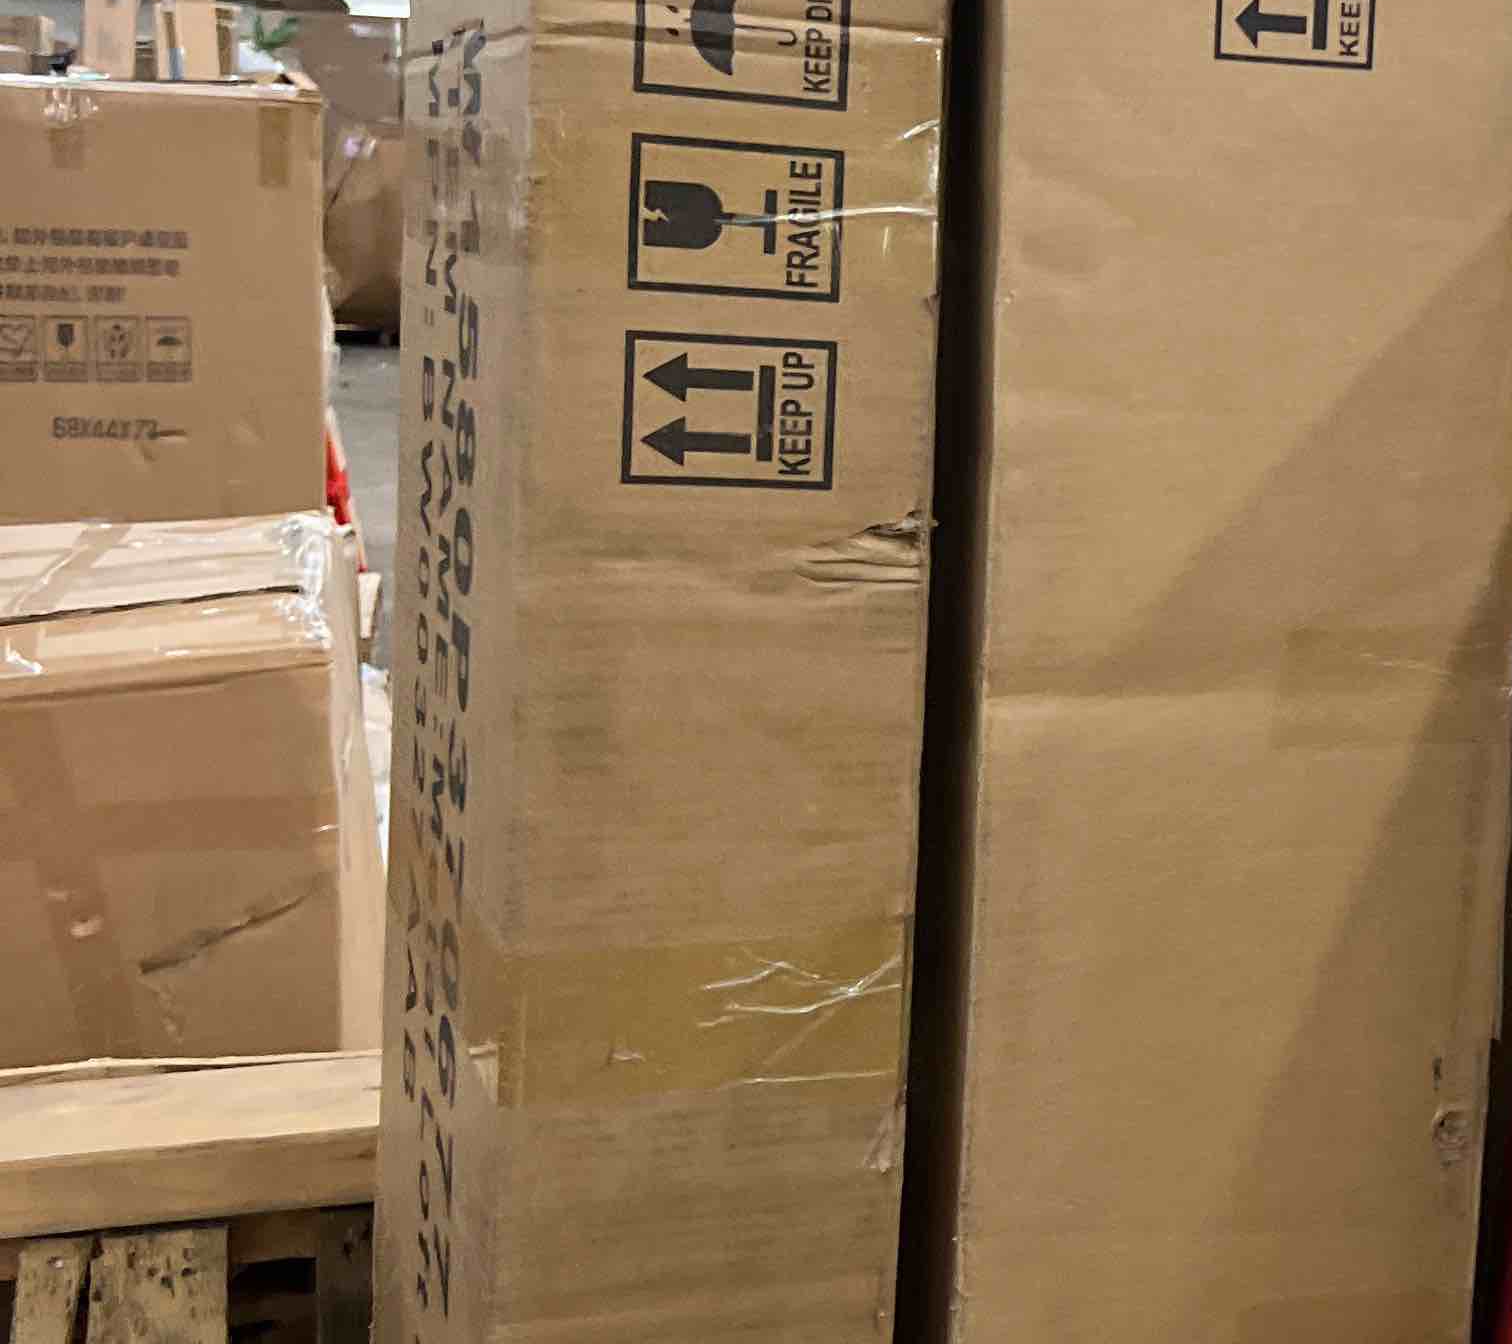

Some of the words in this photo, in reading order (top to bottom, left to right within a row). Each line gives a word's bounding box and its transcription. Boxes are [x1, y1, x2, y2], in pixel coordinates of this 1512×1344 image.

[803, 28, 831, 94] KEEP
[785, 161, 823, 287] FRAGILE
[783, 351, 815, 390] UP
[778, 399, 814, 475] KEEP
